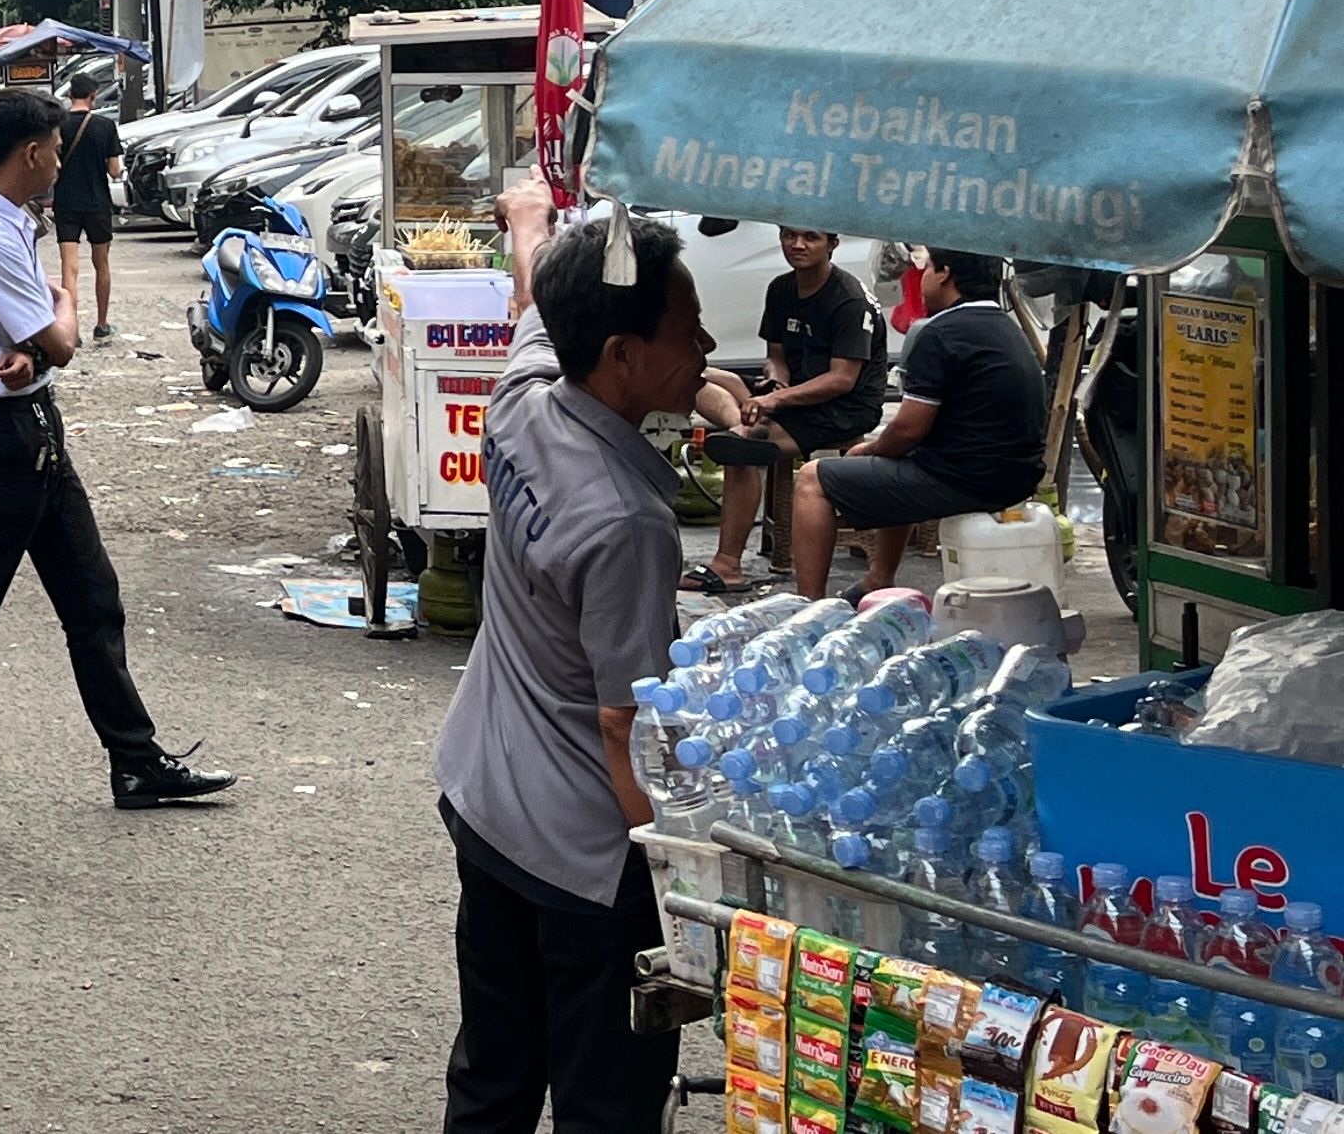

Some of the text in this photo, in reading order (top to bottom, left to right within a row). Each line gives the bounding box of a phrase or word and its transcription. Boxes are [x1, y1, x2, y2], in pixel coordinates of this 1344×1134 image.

[784, 88, 1017, 154] Kebaikan
[653, 135, 835, 199] Mineral
[851, 153, 1144, 239] Terlindungi
[446, 403, 487, 437] TE
[440, 451, 486, 486] GU
[1185, 810, 1290, 913] Le
[1129, 1066, 1192, 1085] Cappuccino
[1137, 1042, 1209, 1078] Good Day
